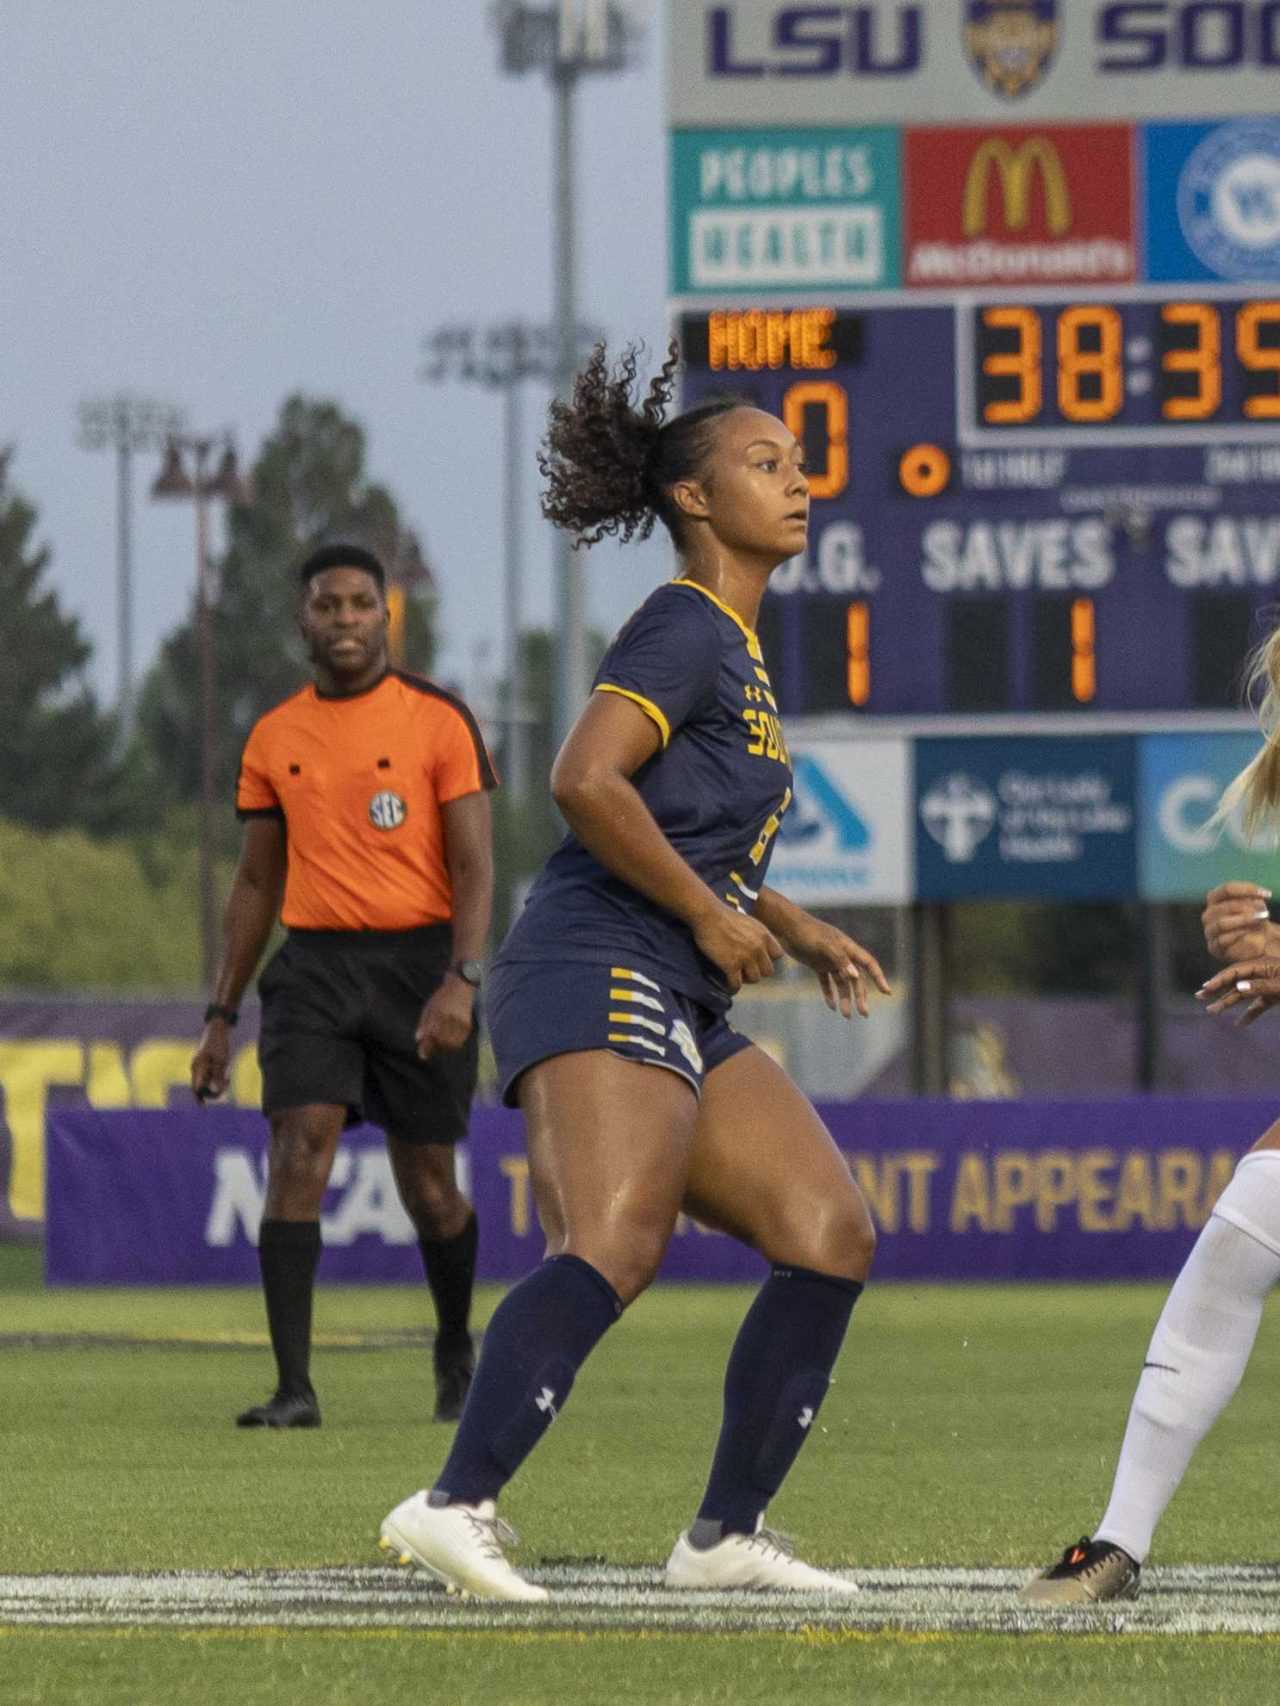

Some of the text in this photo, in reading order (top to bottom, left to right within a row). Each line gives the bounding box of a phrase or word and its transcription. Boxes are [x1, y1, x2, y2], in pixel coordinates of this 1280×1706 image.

[708, 4, 925, 79] LSU
[702, 148, 873, 198] PEOPLES
[708, 306, 837, 371] HOME
[783, 378, 848, 498] 0
[921, 517, 1115, 592] SAVES
[846, 601, 871, 706] 1
[1071, 598, 1096, 703] 1
